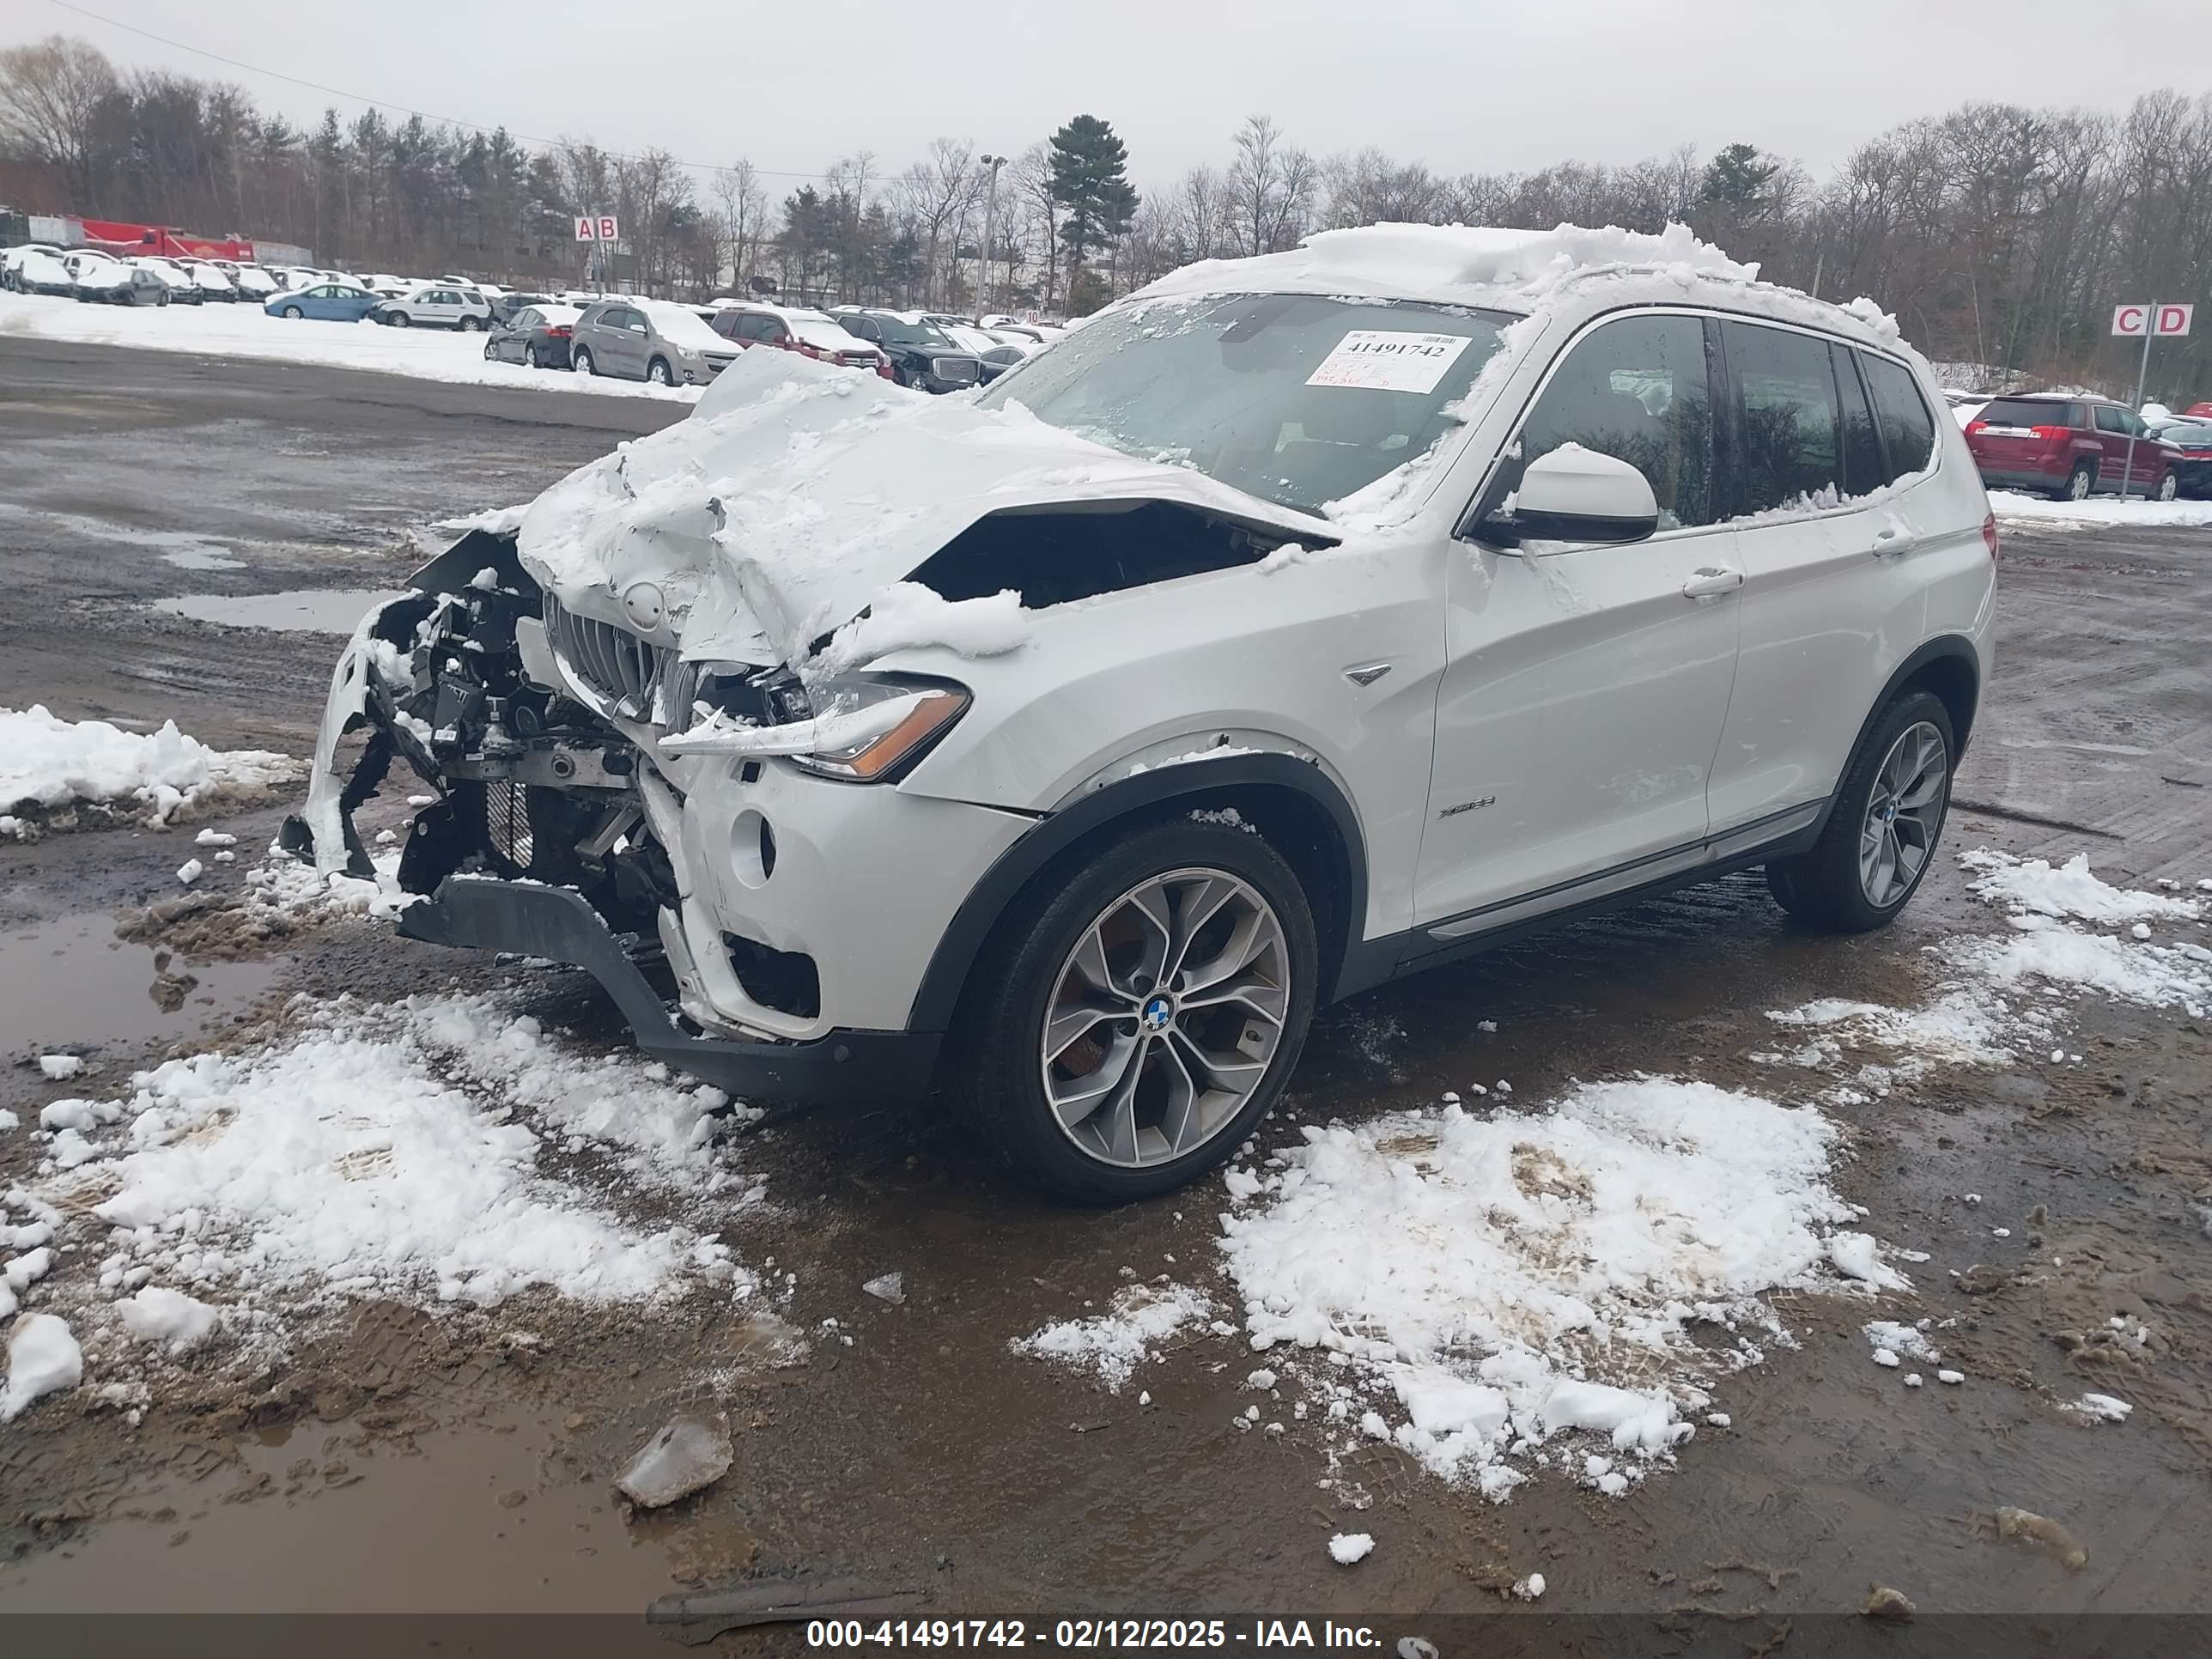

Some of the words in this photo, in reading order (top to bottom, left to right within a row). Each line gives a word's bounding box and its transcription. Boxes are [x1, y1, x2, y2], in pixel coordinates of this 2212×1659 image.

[580, 220, 592, 238] A
[601, 219, 614, 237] B
[1028, 311, 1038, 323] 10
[2118, 308, 2142, 332] C
[2160, 307, 2185, 332] D
[1347, 342, 1445, 357] 41491742
